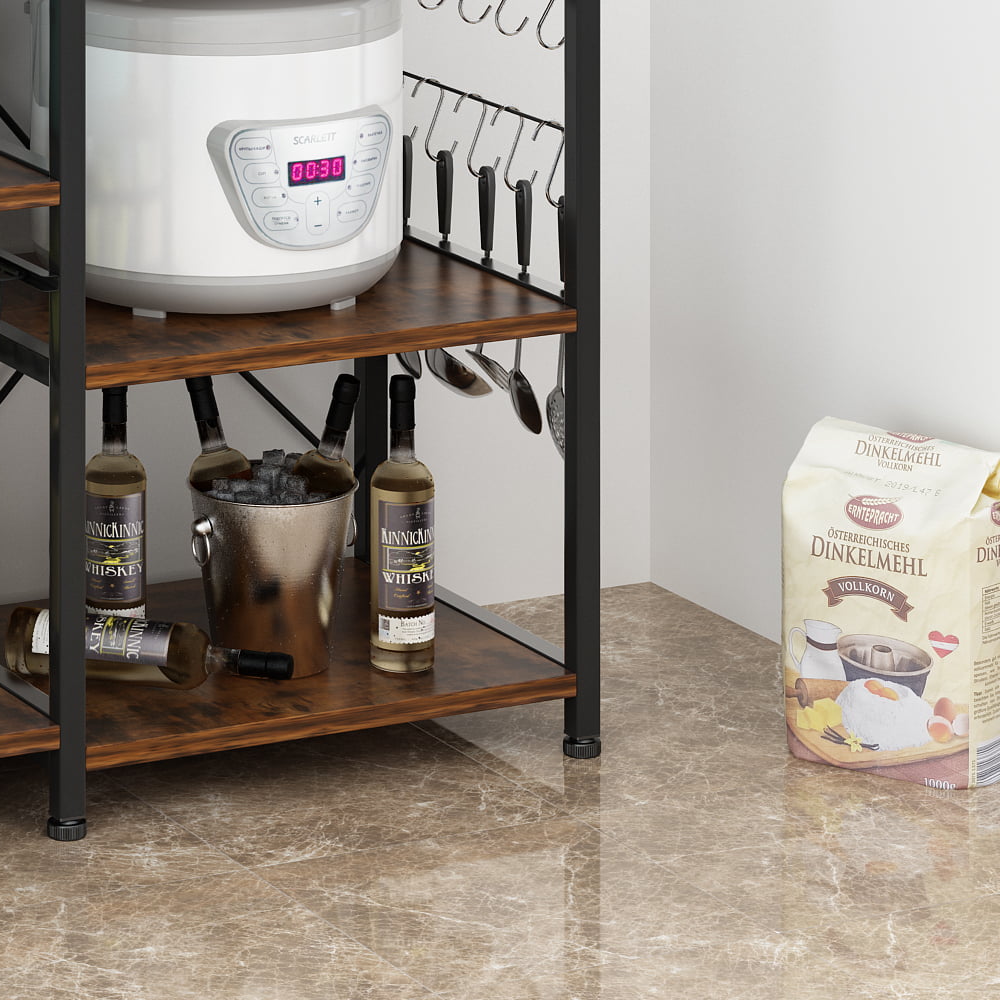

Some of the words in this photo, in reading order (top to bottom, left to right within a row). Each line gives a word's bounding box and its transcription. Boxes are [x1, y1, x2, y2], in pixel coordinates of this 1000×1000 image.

[293, 131, 336, 145] SCARLETT
[292, 158, 342, 181] 00:30
[855, 439, 942, 467] DINKELMEHL
[877, 459, 913, 472] VOLLKORN
[848, 504, 900, 525] ERNTEPRACHT
[827, 527, 910, 553] ÖSTERREICHISCHES
[811, 534, 927, 577] DINKELMEHL
[838, 581, 895, 602] VOLLKORN
